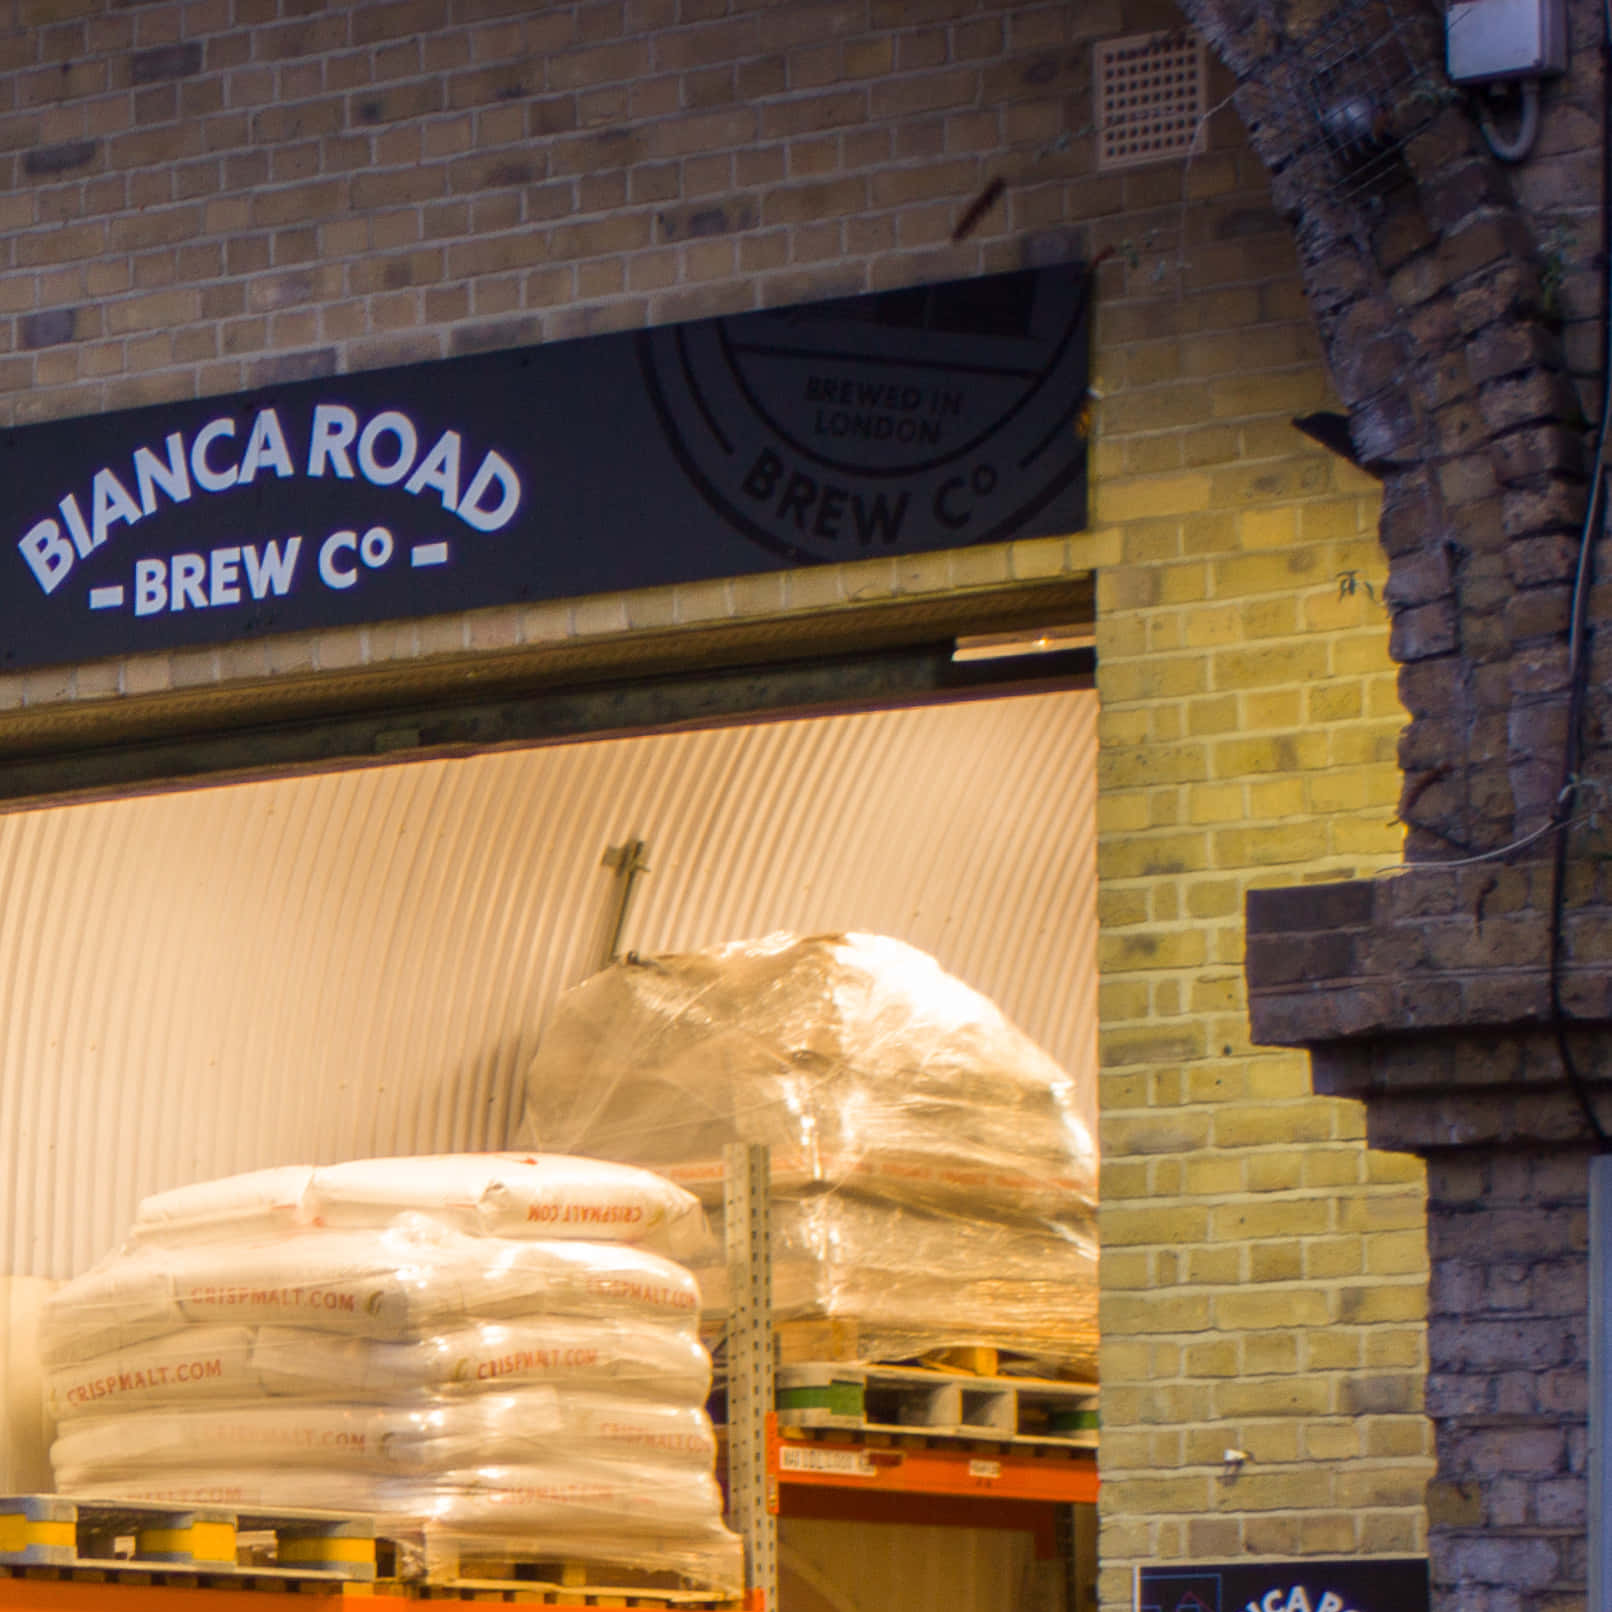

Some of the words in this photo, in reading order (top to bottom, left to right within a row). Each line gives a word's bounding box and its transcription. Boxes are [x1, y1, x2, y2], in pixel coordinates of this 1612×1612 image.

[18, 408, 294, 595] BIANCA
[308, 404, 522, 532] ROAD
[741, 447, 911, 546] BREW
[135, 534, 303, 617] BREW
[191, 1287, 356, 1313] CRISPMALT.COM
[66, 1358, 223, 1408] CRISPMALT.COM
[477, 1349, 599, 1382] CRISPMALT.COM
